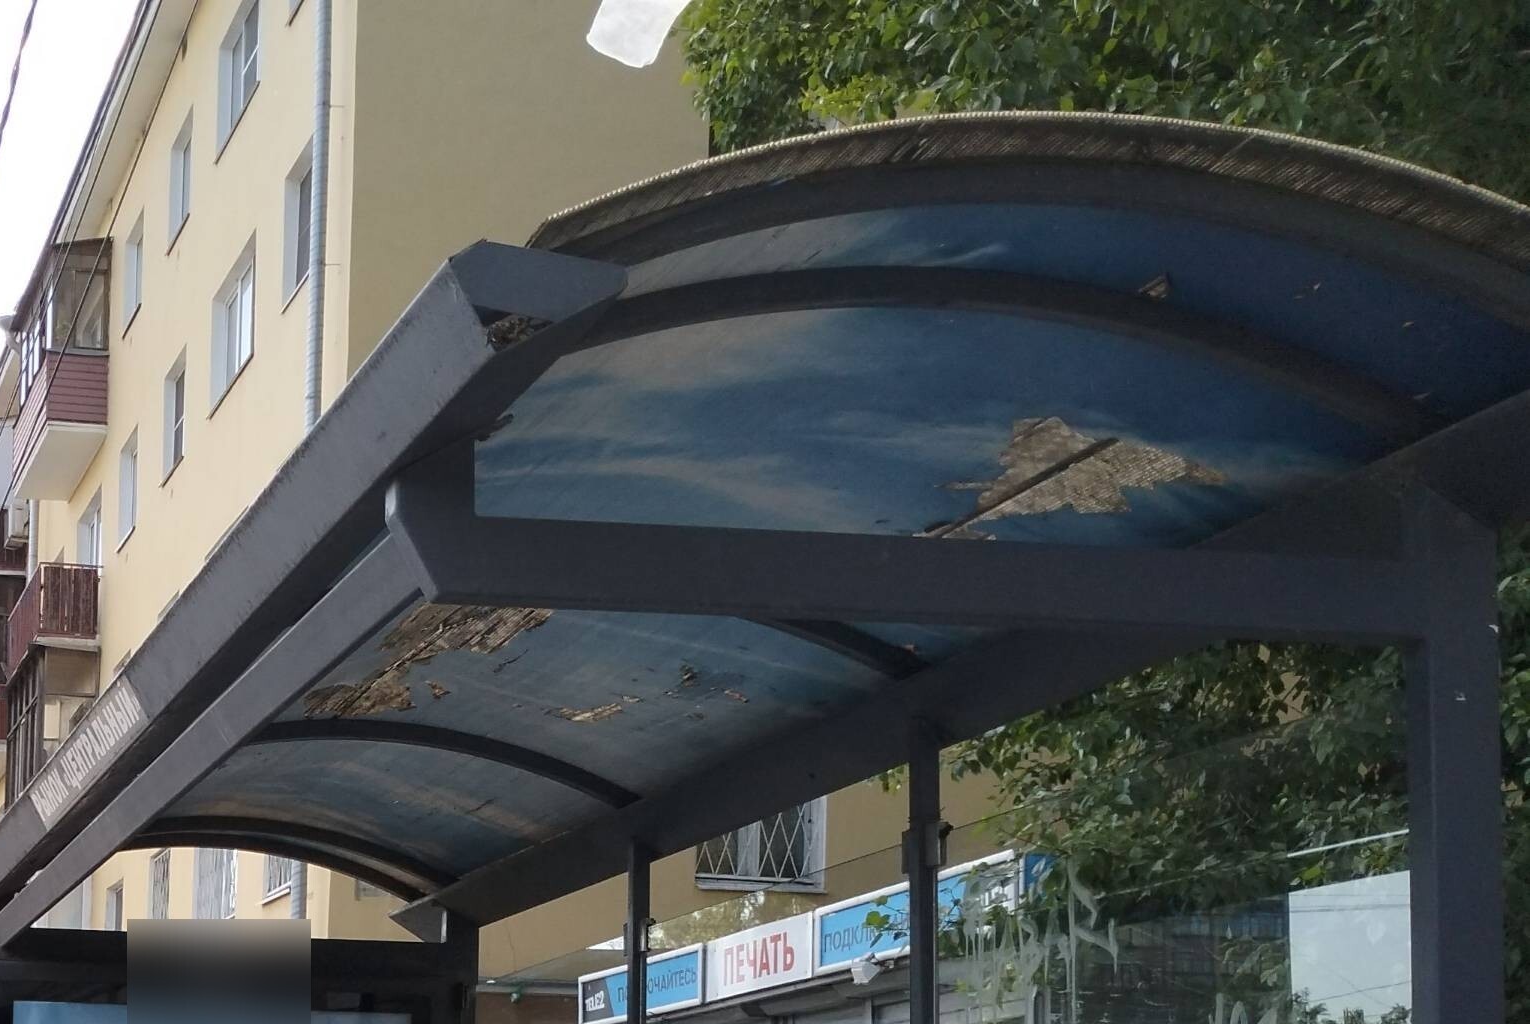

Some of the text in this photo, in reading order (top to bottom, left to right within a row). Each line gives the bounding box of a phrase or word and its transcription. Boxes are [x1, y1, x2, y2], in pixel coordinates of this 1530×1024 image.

[30, 768, 70, 822] РЫНОК
[723, 932, 795, 987] ПЕЧАТЬ
[585, 990, 605, 1012] TELE2
